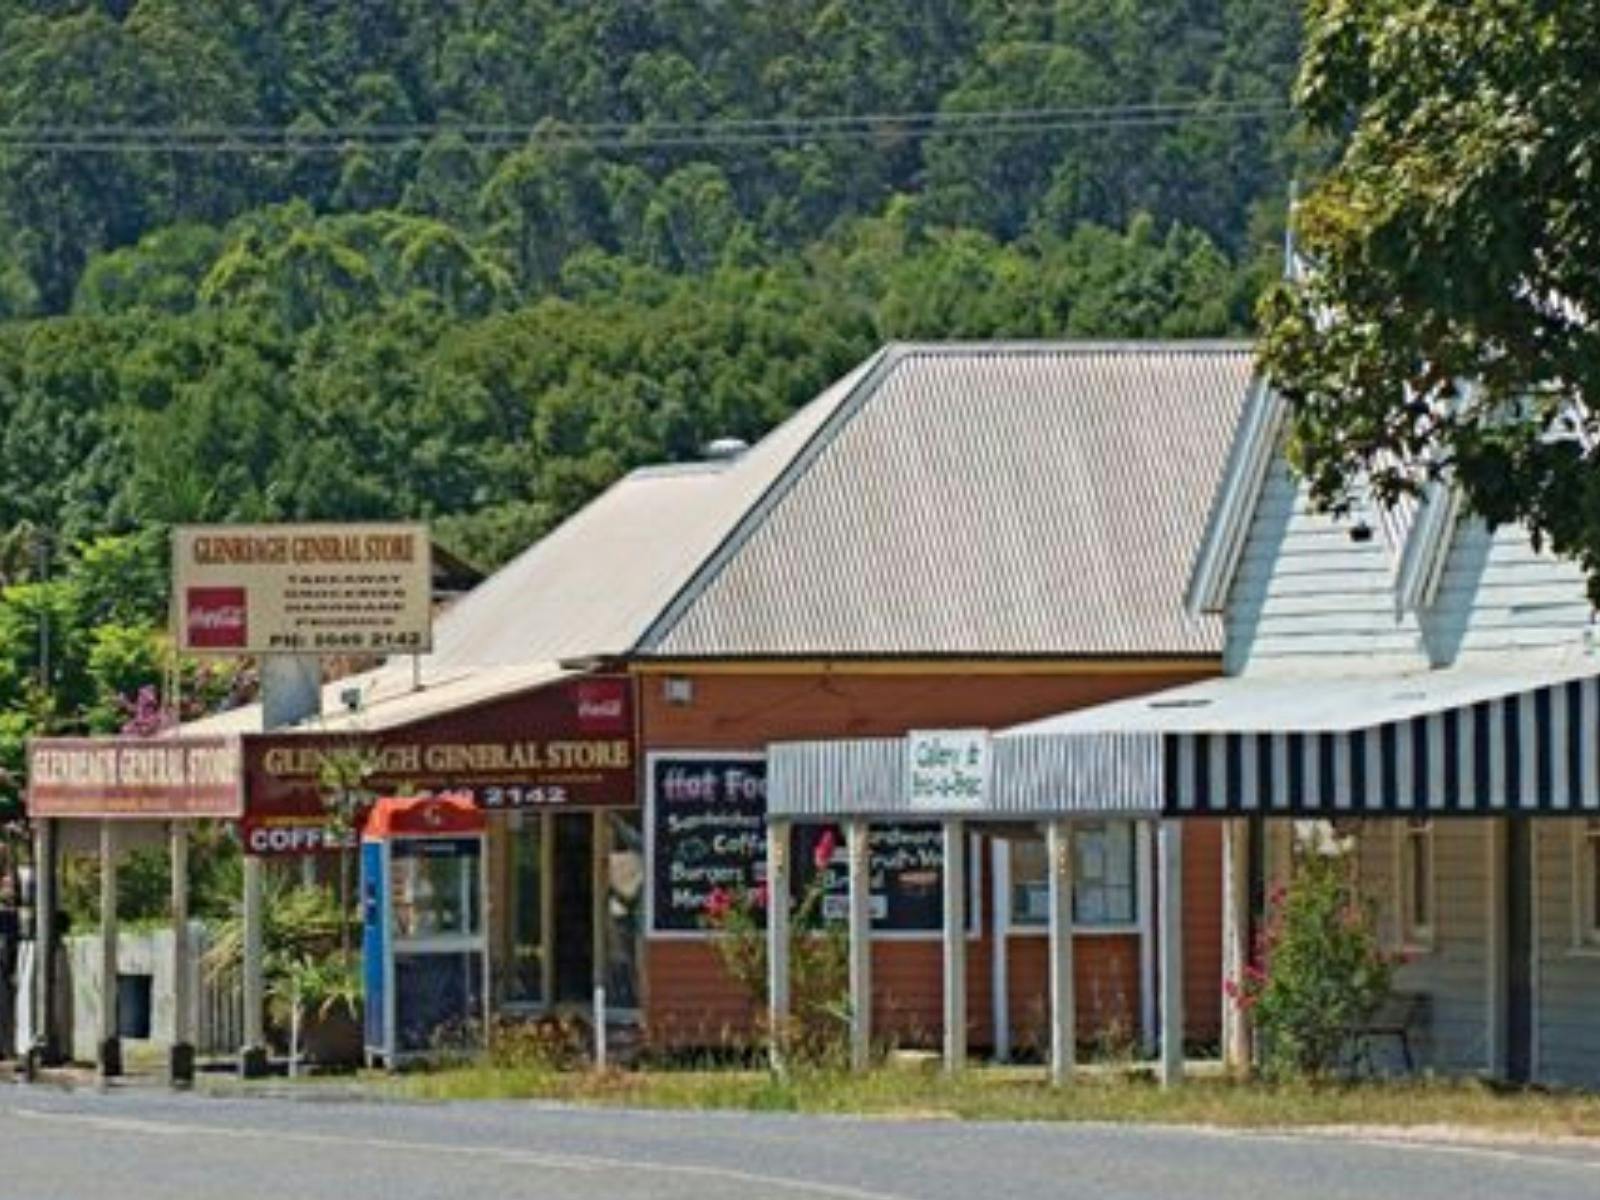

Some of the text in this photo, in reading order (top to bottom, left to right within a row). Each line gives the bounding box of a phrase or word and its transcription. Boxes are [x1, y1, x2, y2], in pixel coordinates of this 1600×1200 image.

[292, 536, 361, 563] GENERAL
[364, 534, 413, 562] STORE
[424, 744, 543, 771] GENERAL
[547, 740, 629, 768] STORE
[484, 785, 567, 805] 2142
